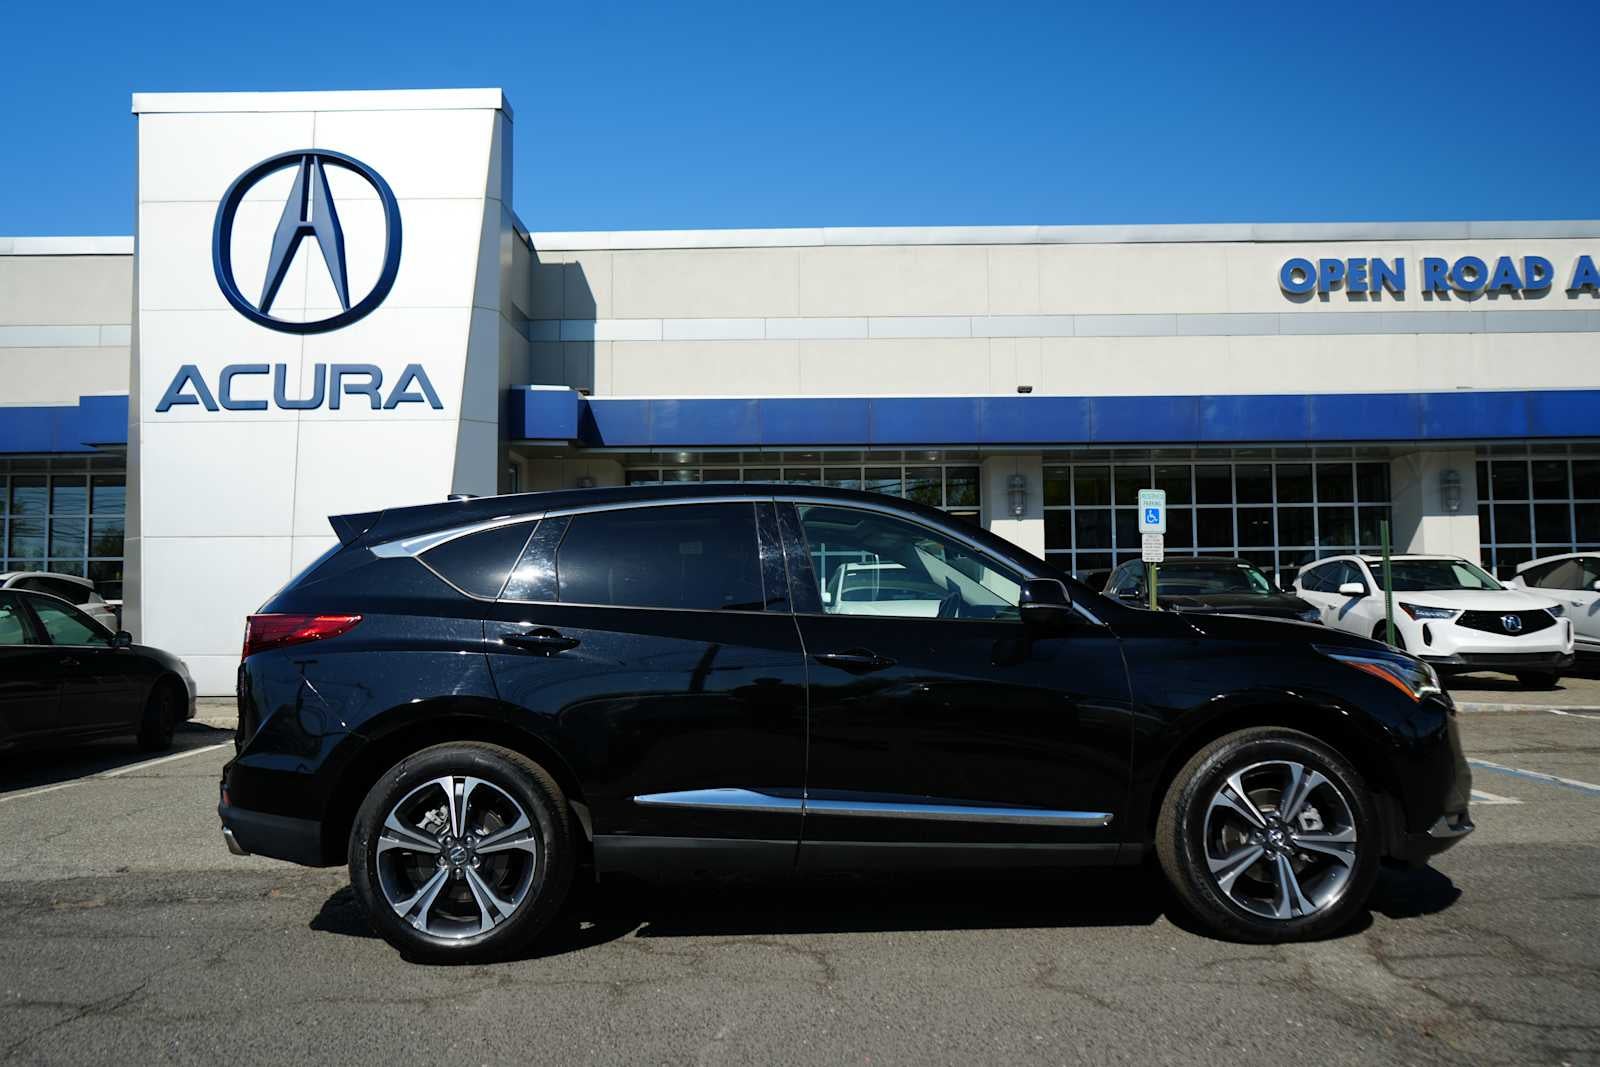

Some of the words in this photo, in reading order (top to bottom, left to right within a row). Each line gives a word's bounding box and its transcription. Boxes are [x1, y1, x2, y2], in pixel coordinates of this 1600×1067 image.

[1280, 257, 1406, 303] OPEN
[1422, 255, 1554, 302] ROAD
[155, 363, 444, 412] ACURA
